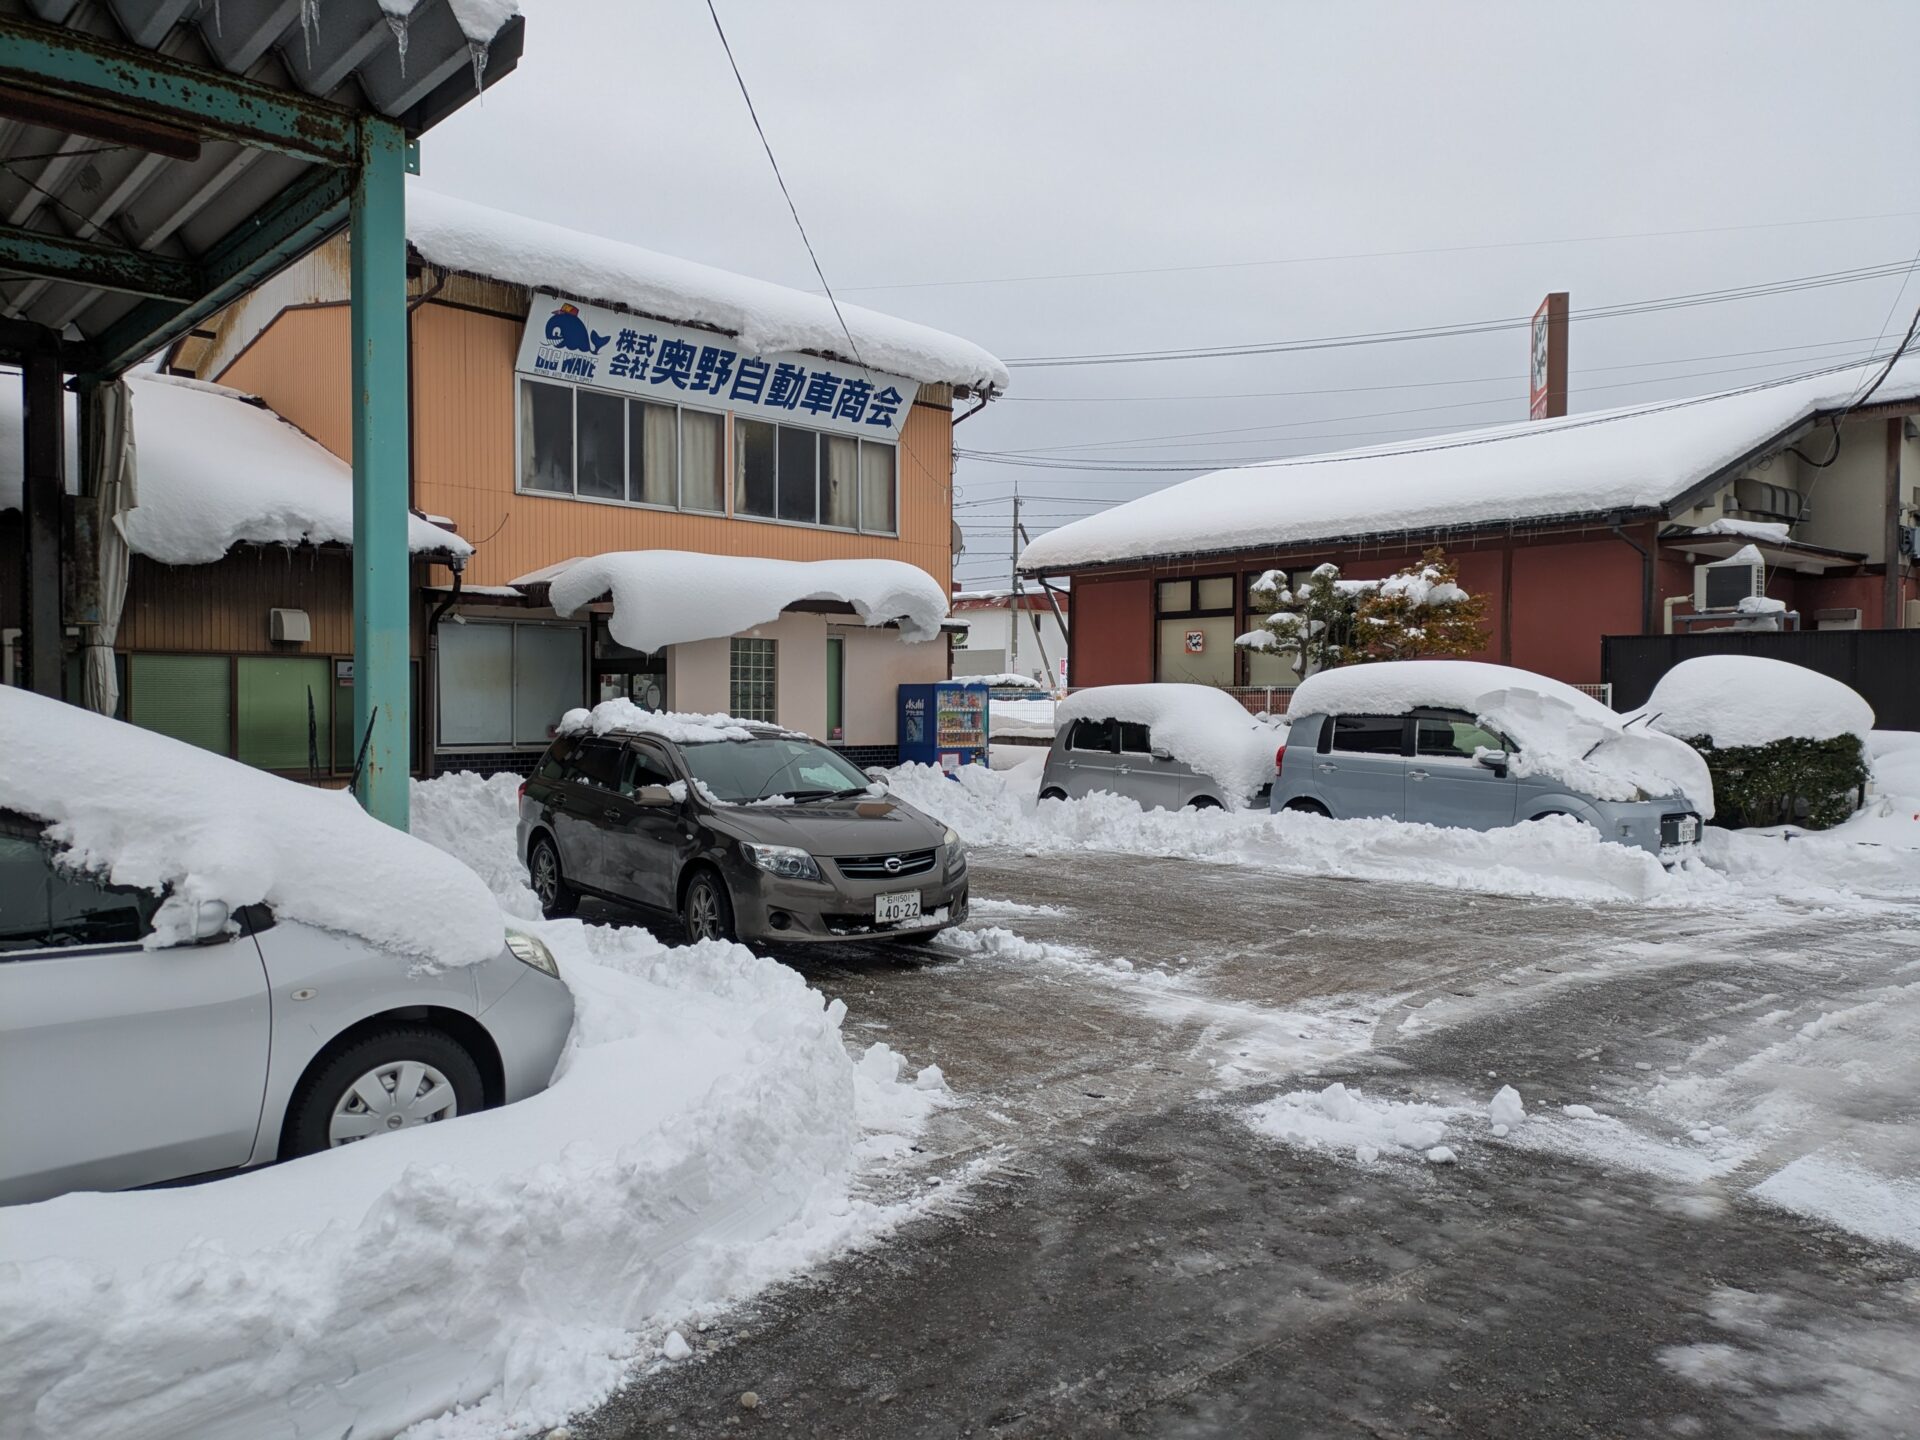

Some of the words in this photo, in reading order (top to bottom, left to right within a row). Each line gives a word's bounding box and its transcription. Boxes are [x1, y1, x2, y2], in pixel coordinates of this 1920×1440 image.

[616, 328, 657, 358] 株式
[535, 347, 561, 370] BIG
[562, 351, 598, 378] WAVE
[609, 353, 650, 381] 会社
[650, 338, 903, 429] 奥野自動車商会
[905, 698, 924, 710] Asahi
